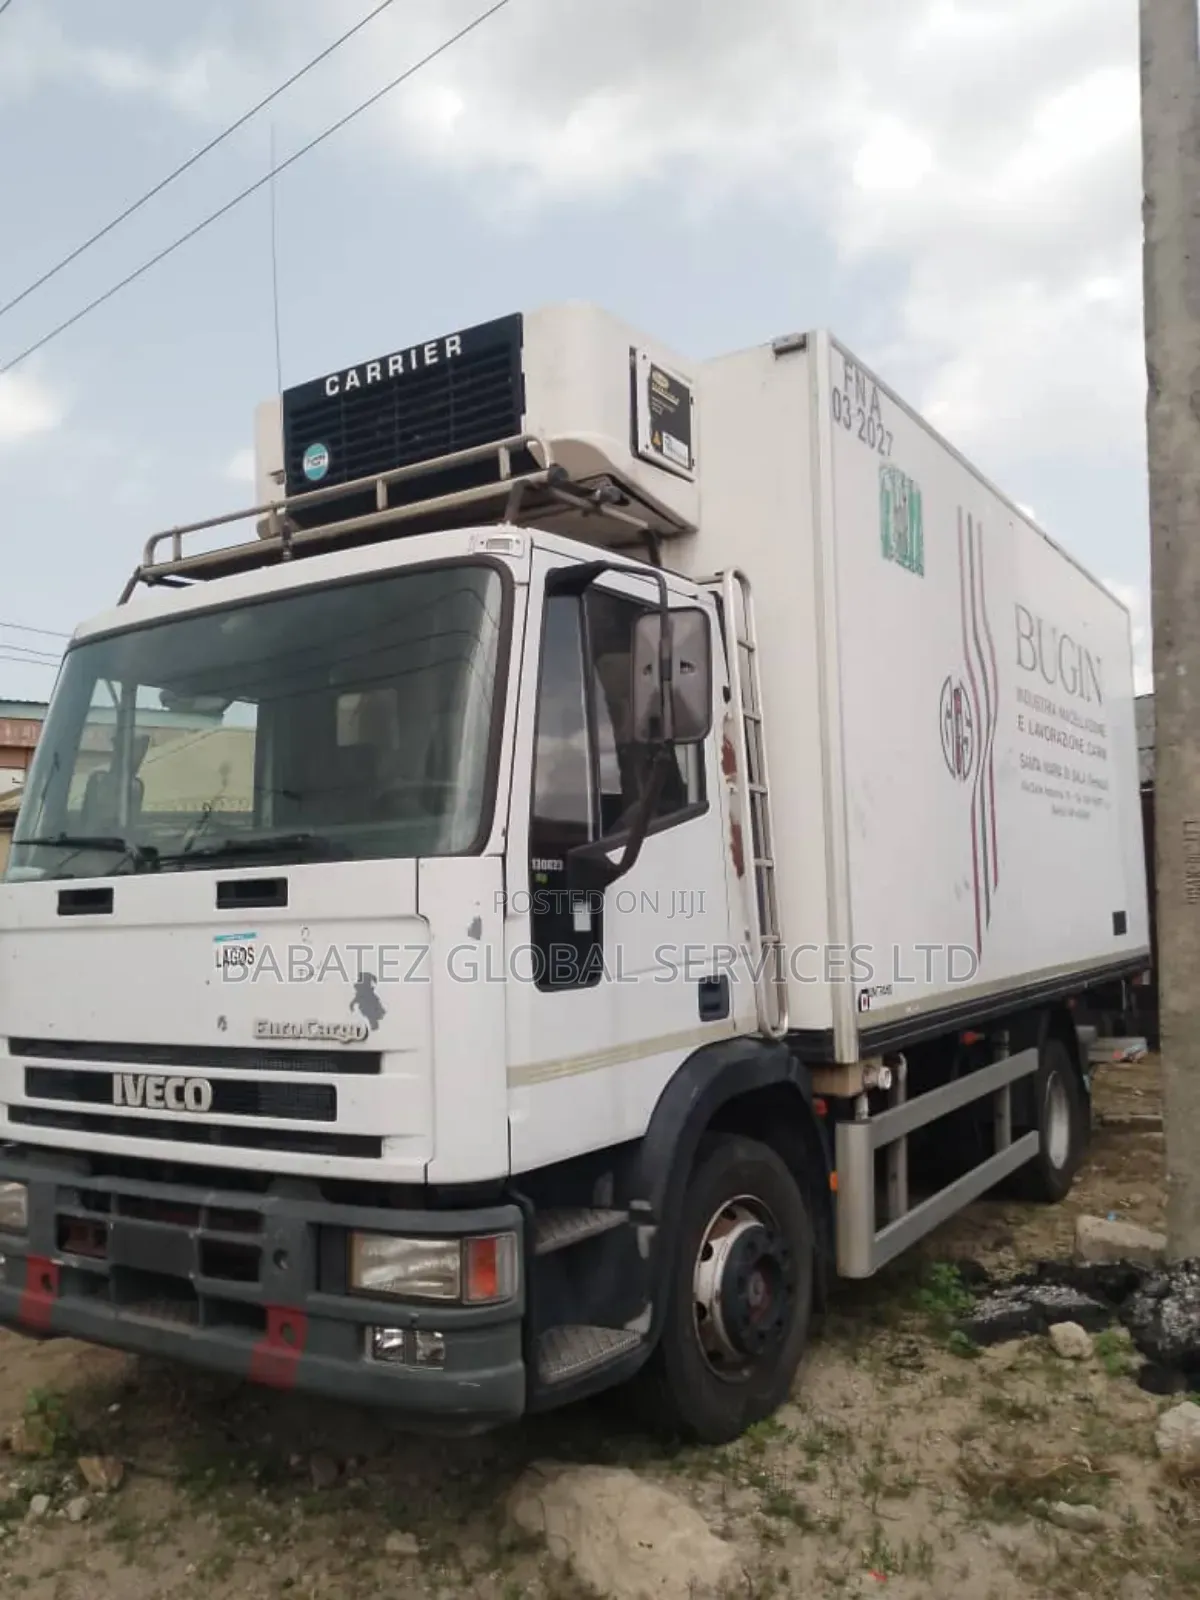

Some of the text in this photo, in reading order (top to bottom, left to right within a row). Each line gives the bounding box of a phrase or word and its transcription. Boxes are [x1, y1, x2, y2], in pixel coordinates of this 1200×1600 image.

[325, 333, 463, 397] CARRIER
[857, 408, 894, 457] 2027
[1014, 602, 1104, 708] BUGIN
[1016, 714, 1025, 732] E
[215, 946, 255, 968] LAGOS
[112, 1072, 213, 1113] IVECO
